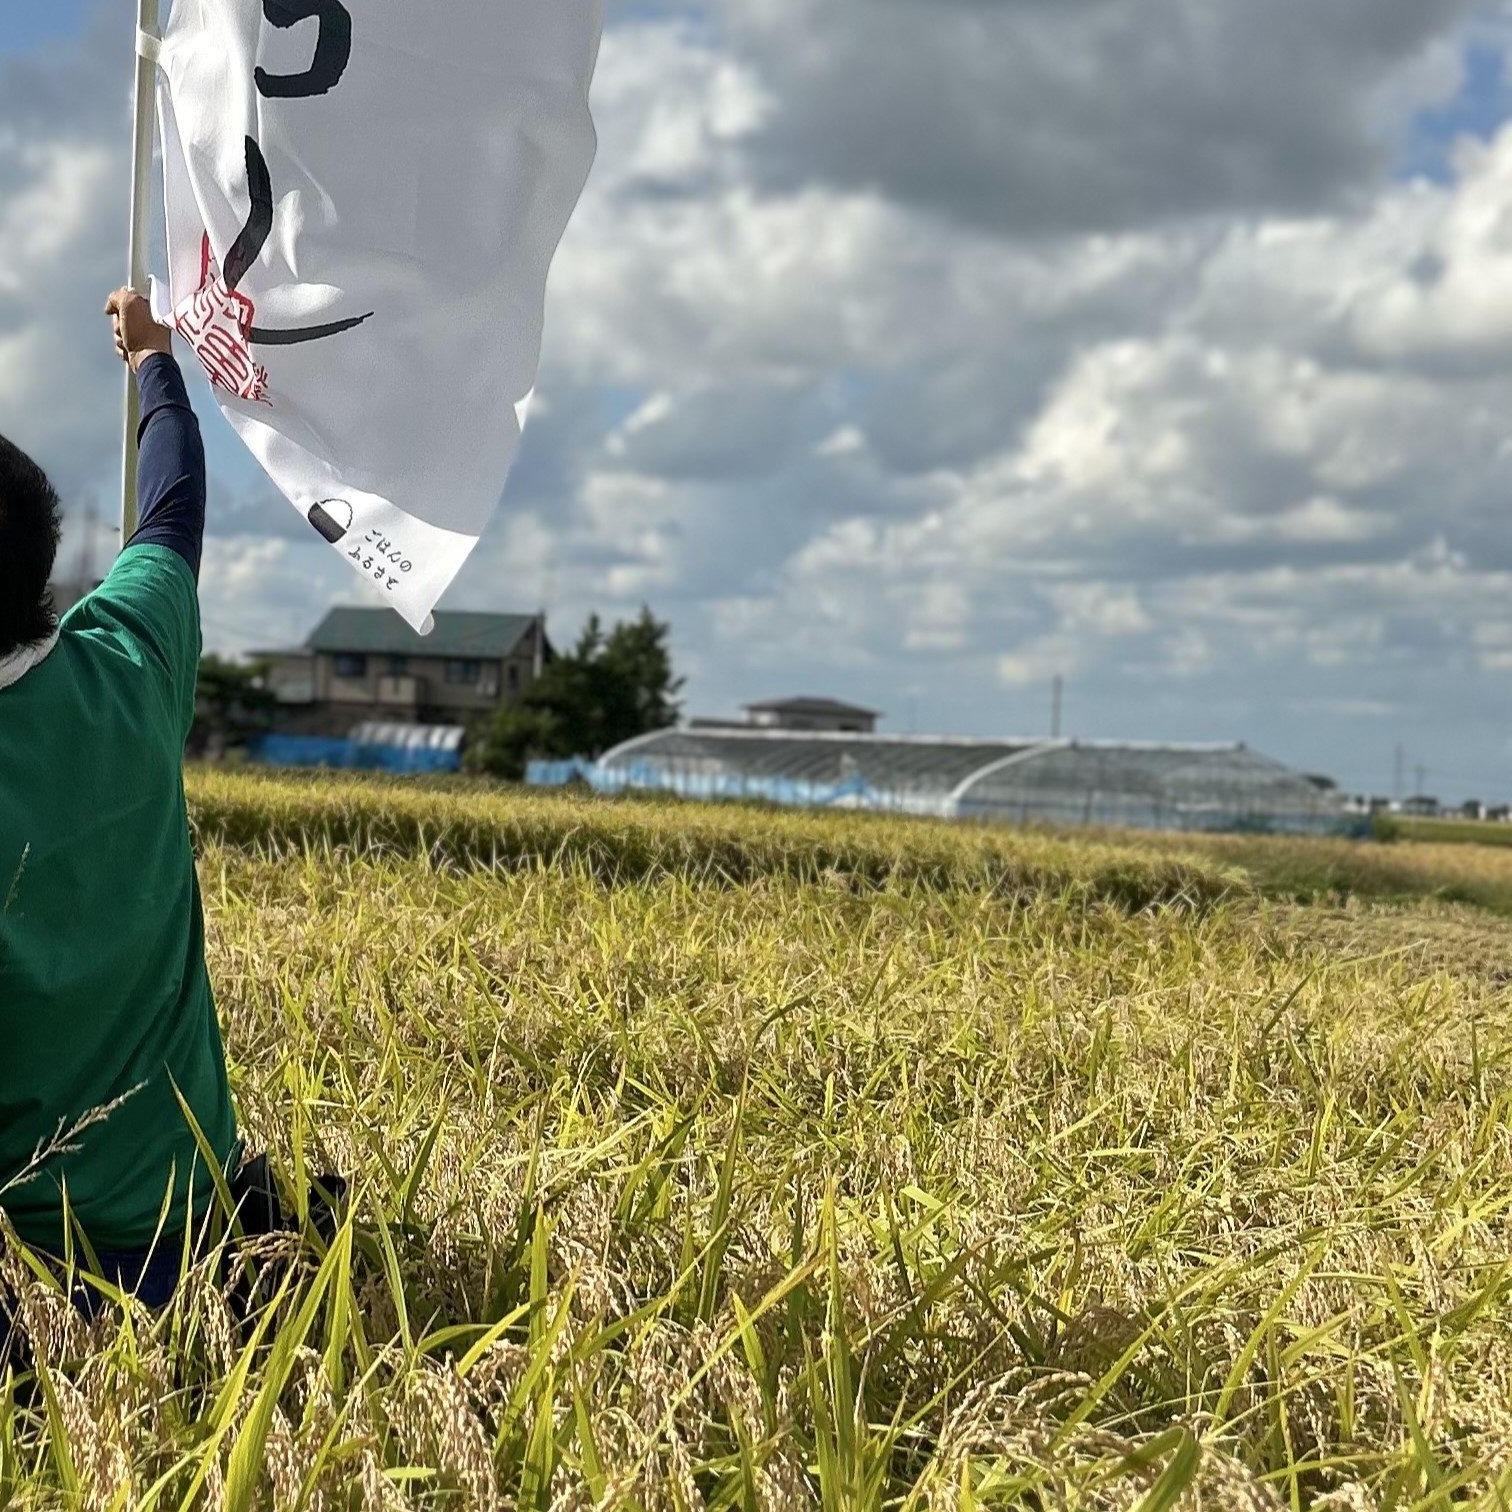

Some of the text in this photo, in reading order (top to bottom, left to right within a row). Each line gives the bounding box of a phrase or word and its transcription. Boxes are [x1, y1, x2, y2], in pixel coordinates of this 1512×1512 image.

[347, 546, 399, 591] ふるさと
[364, 529, 413, 573] ごはんの
